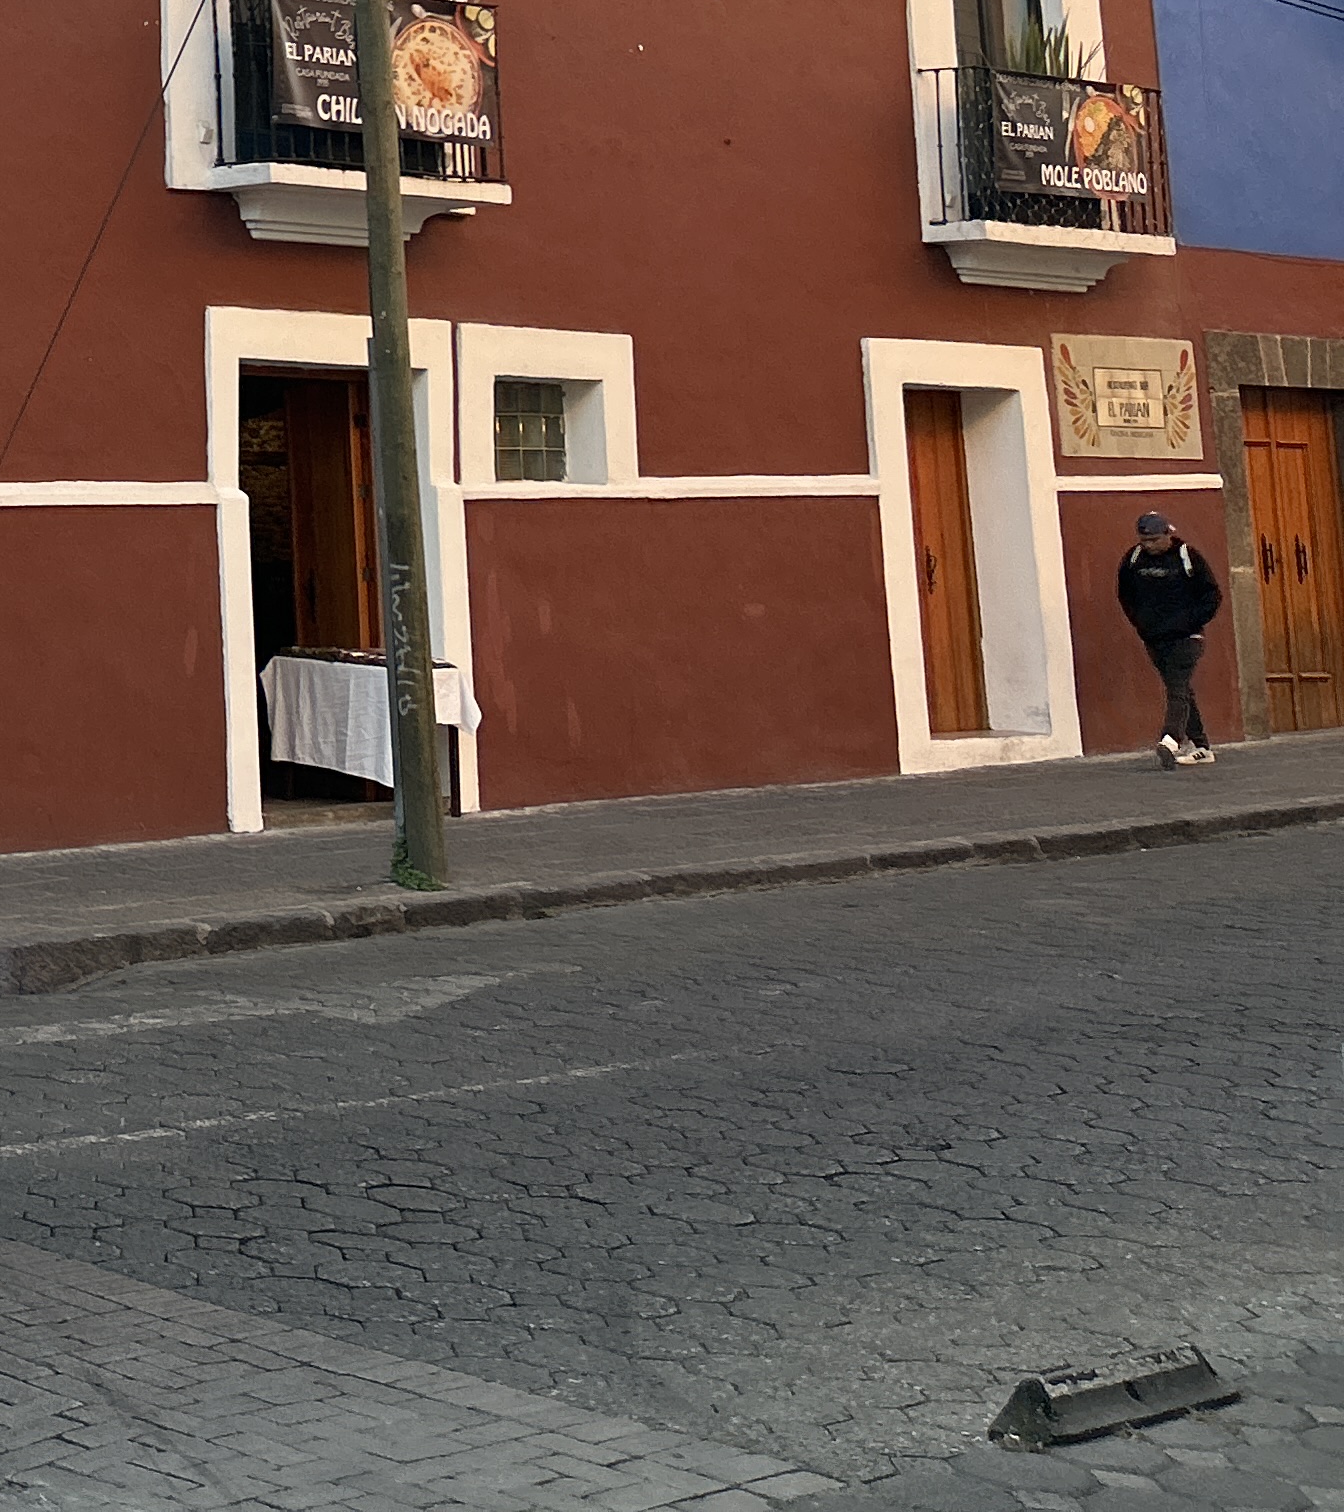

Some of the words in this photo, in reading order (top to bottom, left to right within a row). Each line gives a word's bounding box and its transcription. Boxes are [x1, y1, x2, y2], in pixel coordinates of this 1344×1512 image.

[284, 41, 303, 61] EL
[316, 93, 364, 125] CHIL
[412, 105, 492, 141] NOGADA
[1001, 121, 1016, 138] EL
[1016, 123, 1055, 141] PARIAN
[1041, 163, 1082, 189] MOLE
[1083, 168, 1148, 195] POBLANO
